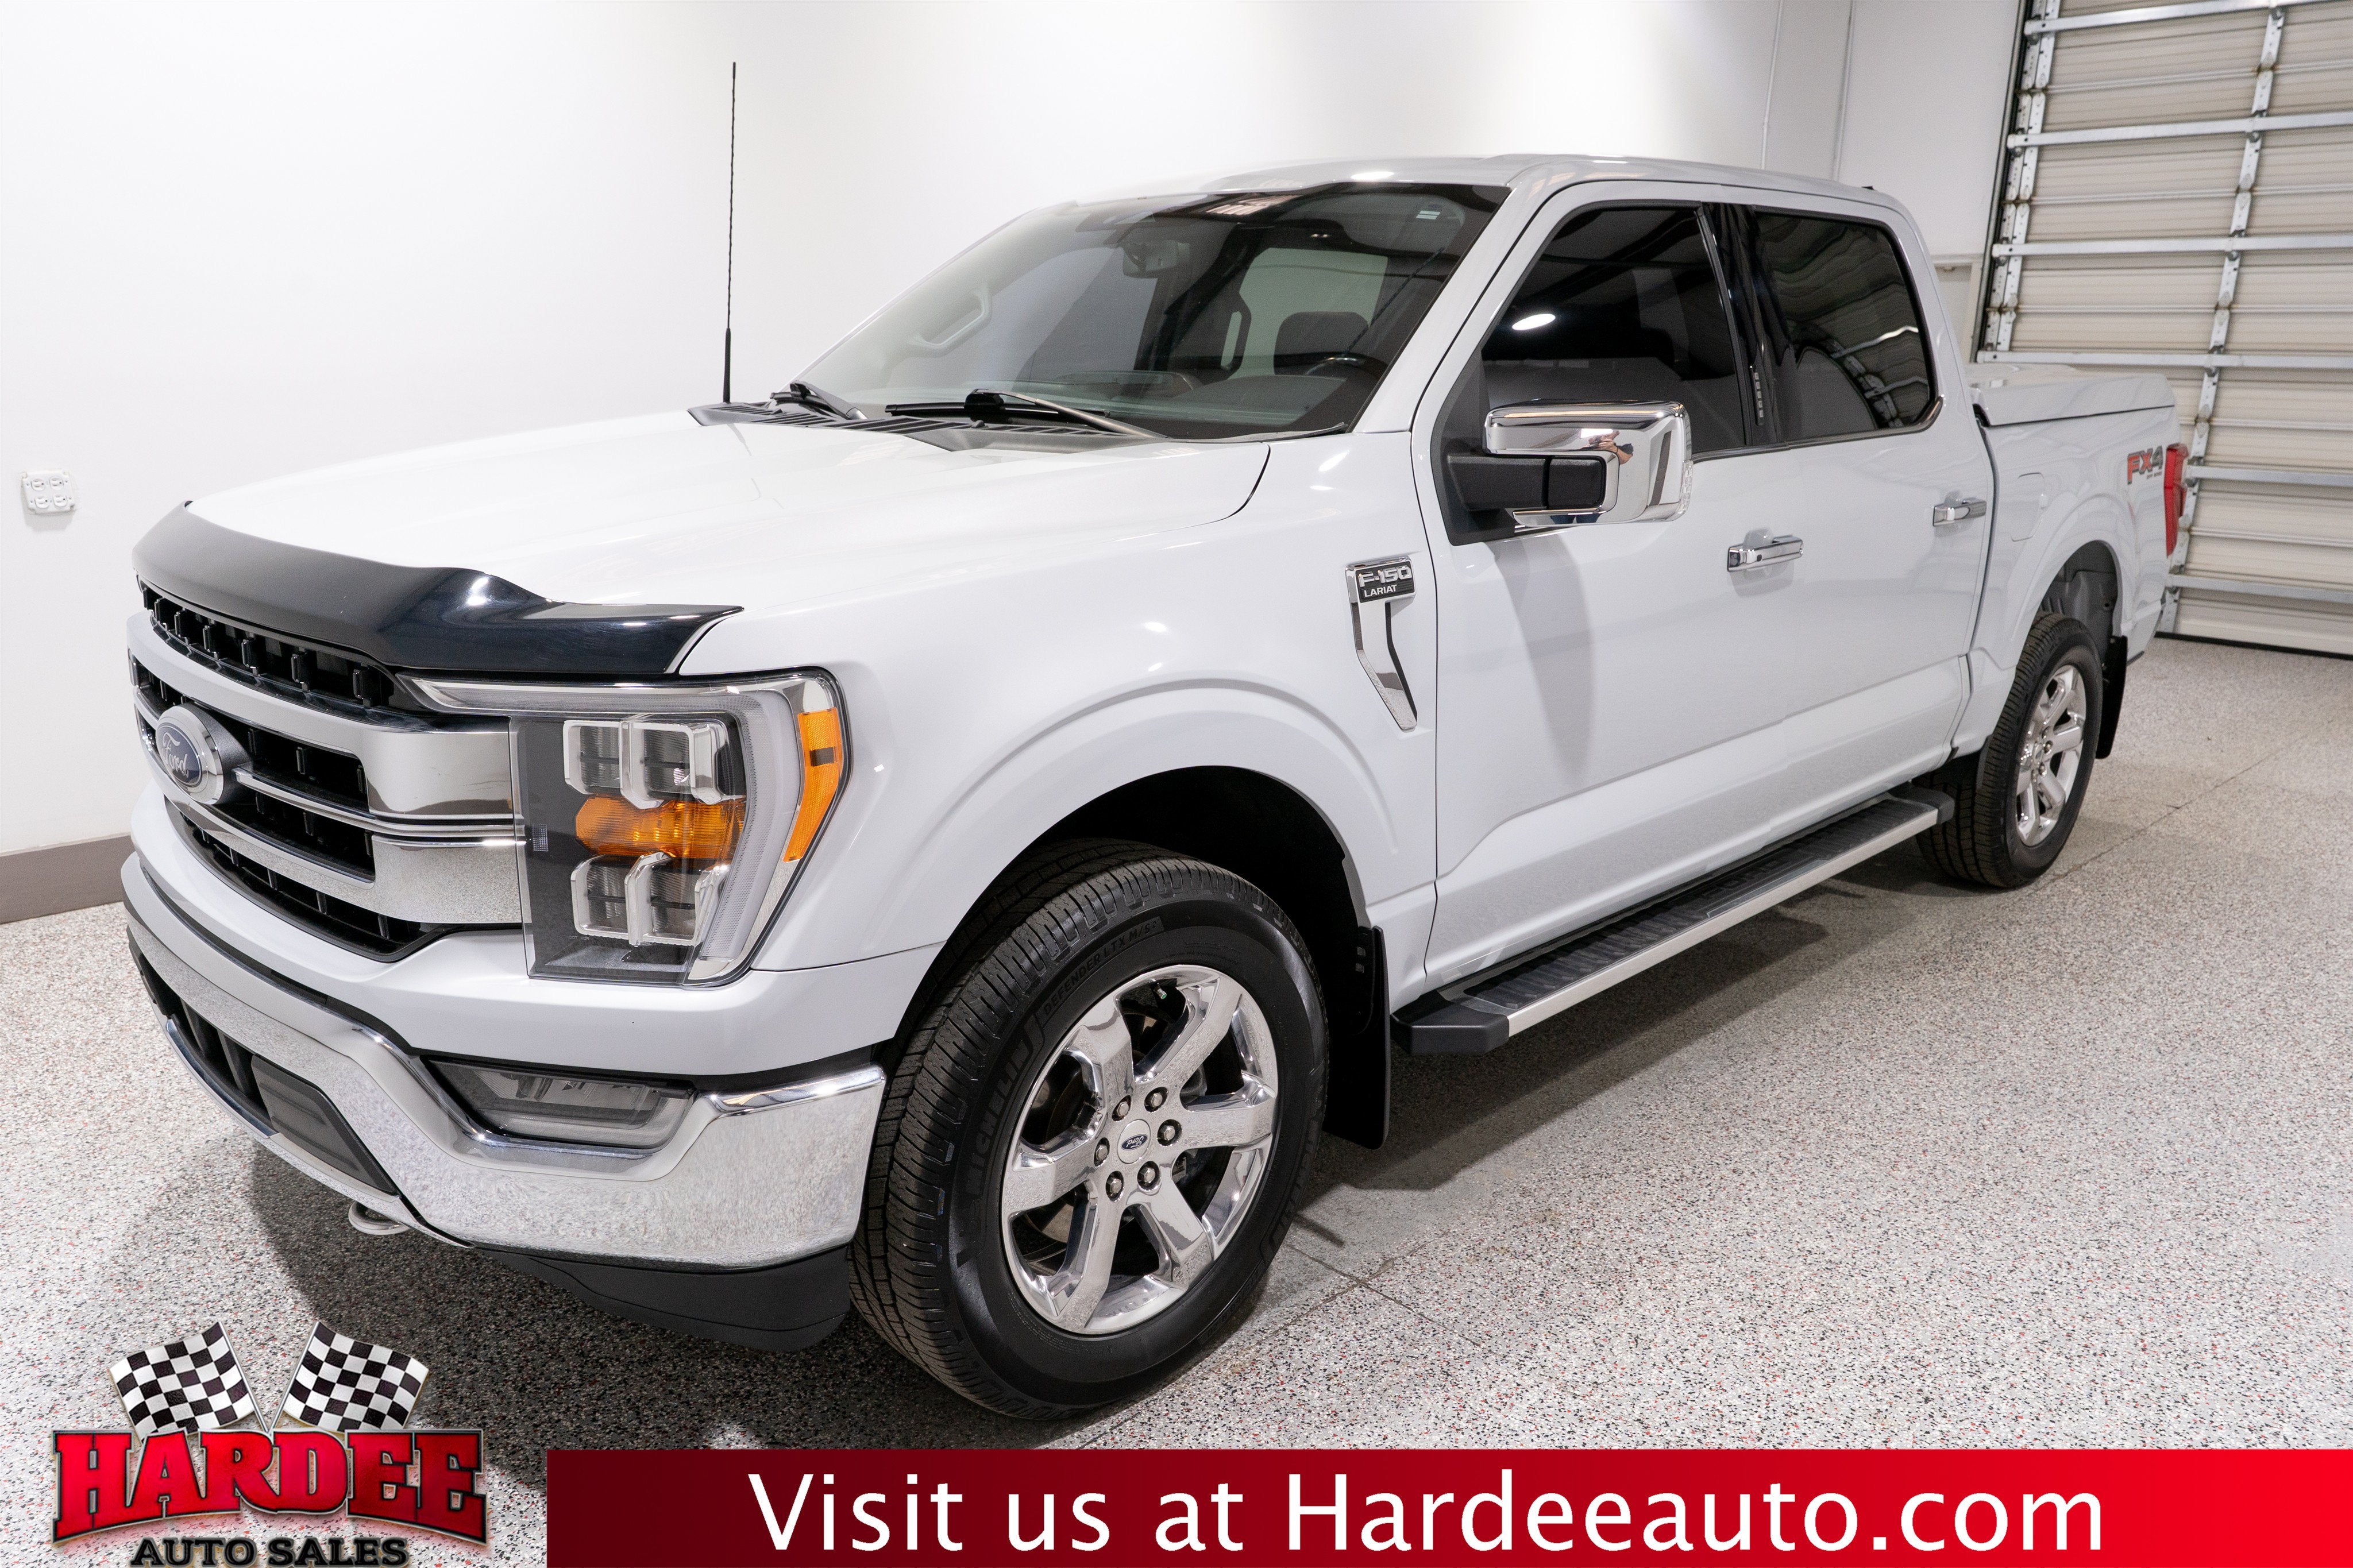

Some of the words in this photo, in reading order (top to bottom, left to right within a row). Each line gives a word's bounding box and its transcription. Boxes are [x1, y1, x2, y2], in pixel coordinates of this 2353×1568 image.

[2127, 445, 2163, 485] FX4
[1358, 565, 1413, 587] F-150
[1364, 584, 1397, 597] LARIAT
[162, 732, 189, 778] Ford
[1043, 953, 1101, 1016] DEFENDER
[1103, 936, 1126, 959] LTX
[964, 1038, 1030, 1195] MICHELIN
[1125, 1135, 1144, 1148] Ford
